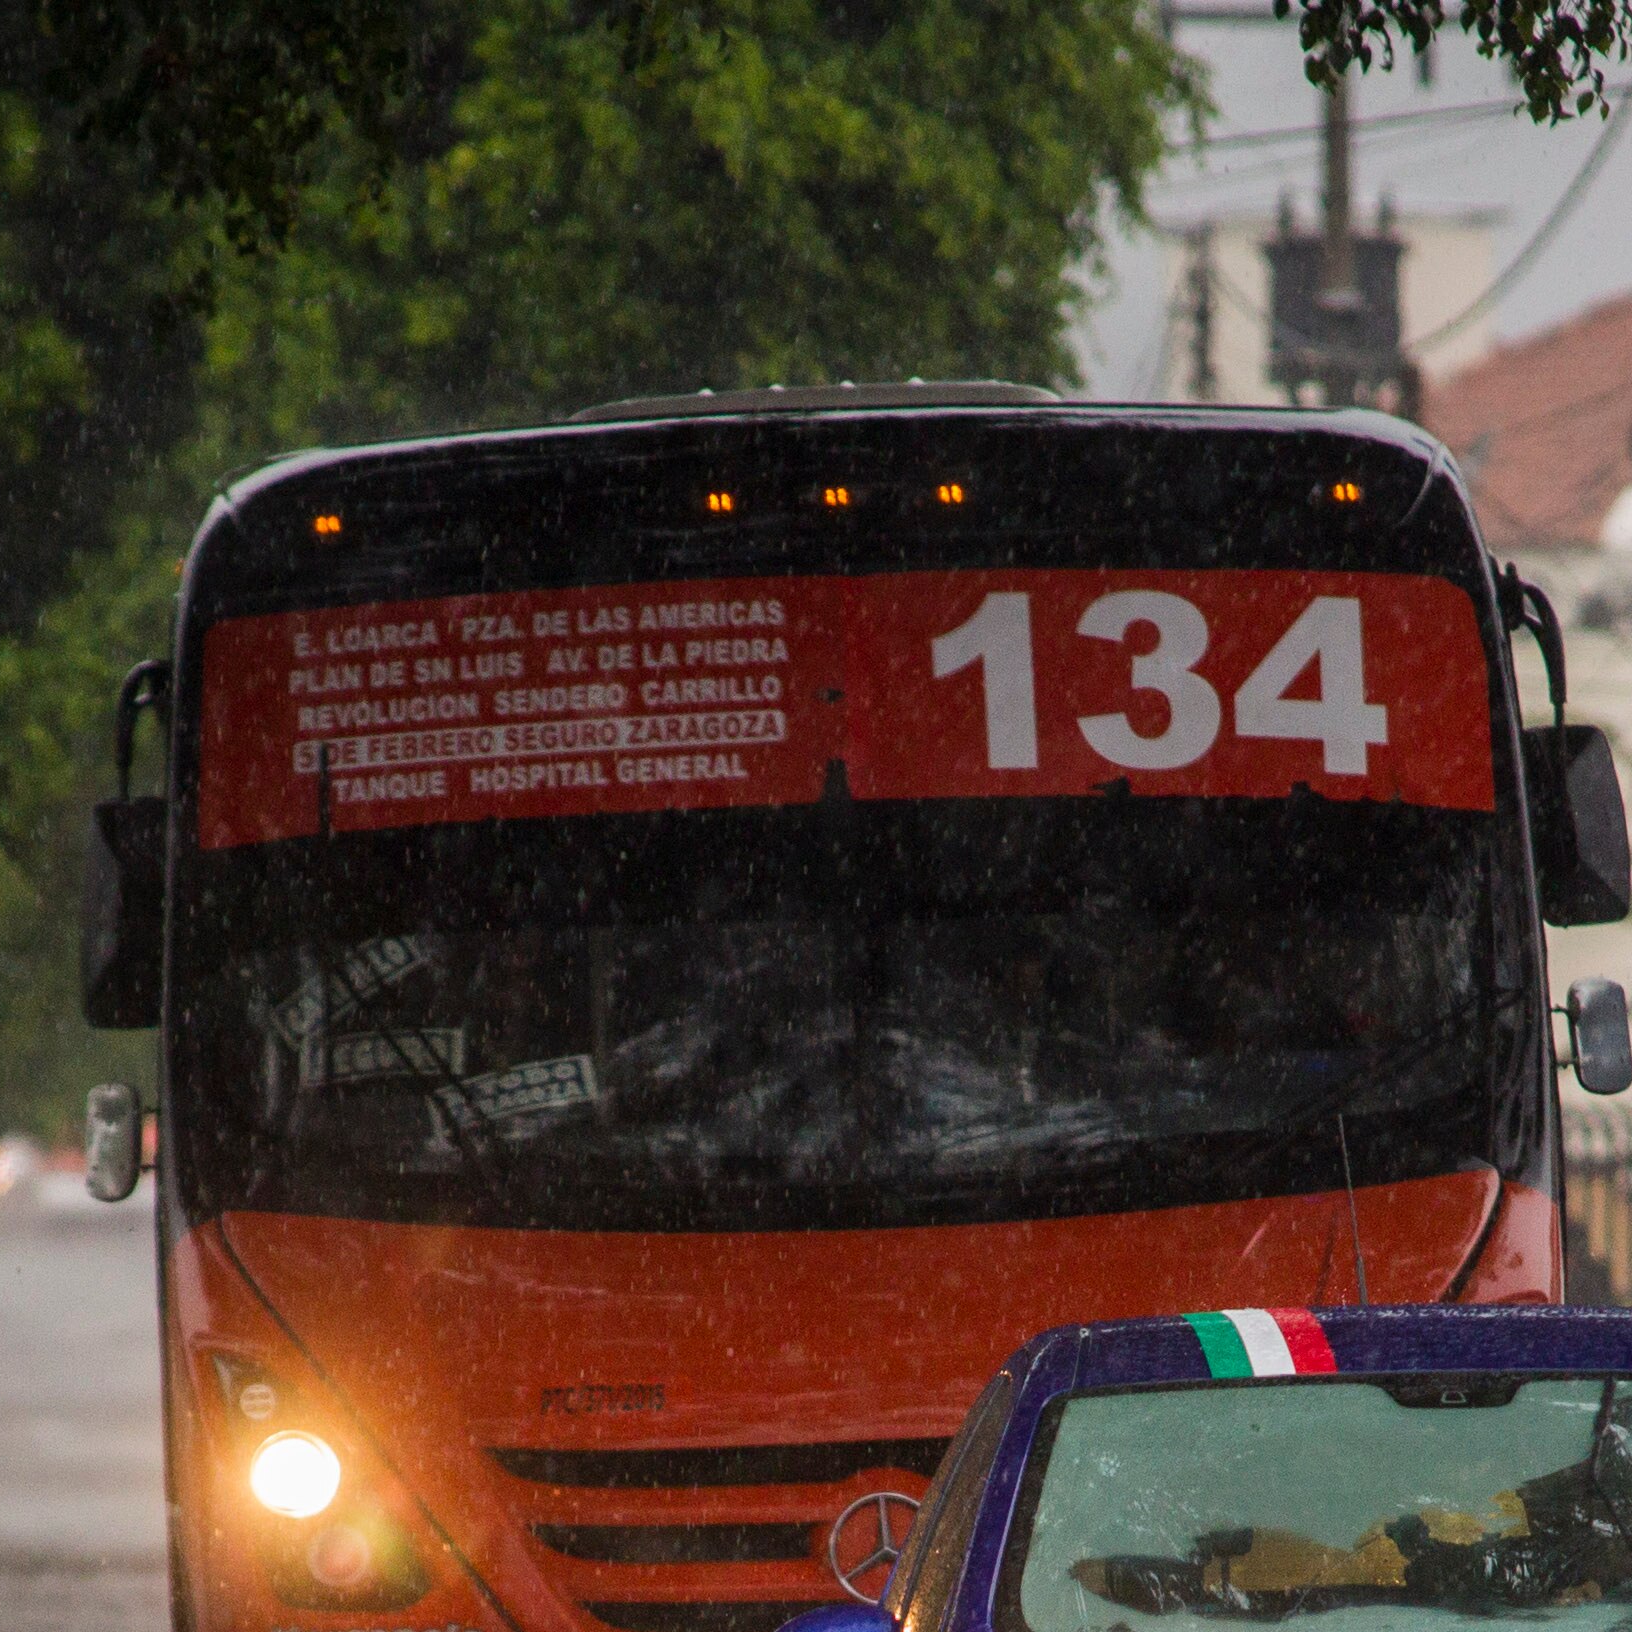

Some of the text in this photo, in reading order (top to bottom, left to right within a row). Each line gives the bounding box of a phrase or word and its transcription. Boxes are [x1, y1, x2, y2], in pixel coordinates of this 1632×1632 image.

[294, 599, 785, 657] E. LOARCA PZA. DE LAS AMERICAS
[288, 637, 789, 695] PLAN DE SN LUIS AV. DE LA PIEDRA
[931, 590, 1388, 775] 134
[298, 675, 779, 731] REVOLUCION SENDERO CARRILLO
[297, 713, 779, 770] 5 DE FEBRERO SEGURO ZARAGOZA
[332, 752, 748, 802] TANQUE HOSPITAL GENERAL
